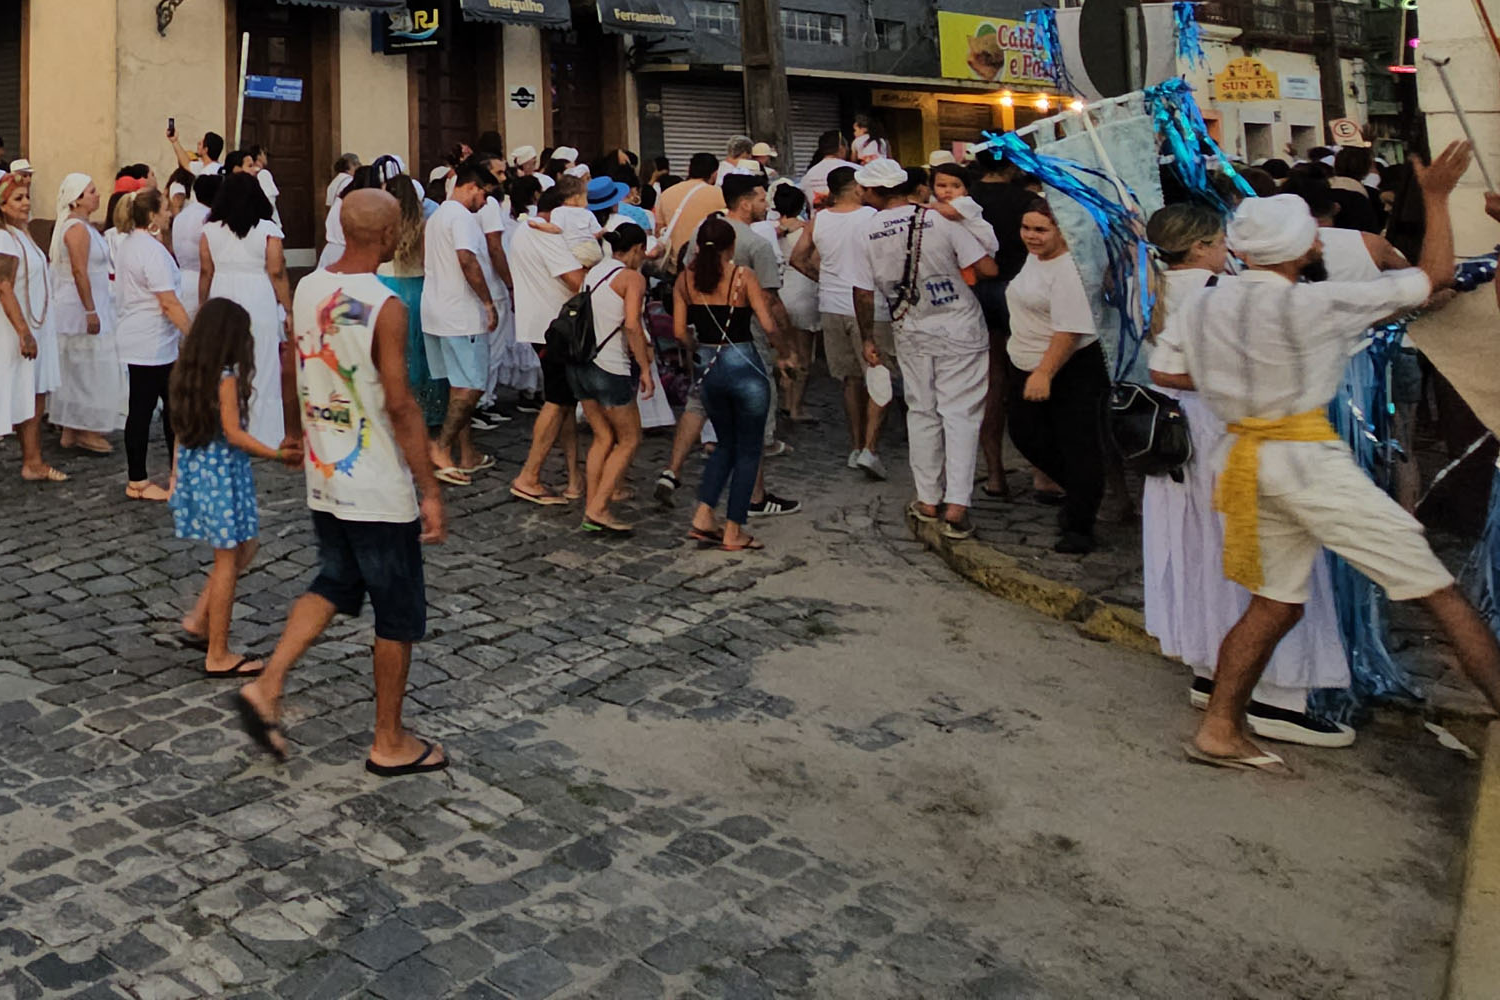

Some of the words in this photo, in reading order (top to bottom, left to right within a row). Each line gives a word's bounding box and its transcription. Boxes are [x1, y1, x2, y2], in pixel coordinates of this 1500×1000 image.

[414, 8, 439, 30] RJ
[613, 8, 676, 26] Ferramentas
[1010, 58, 1018, 75] e
[1222, 81, 1249, 90] SUN
[1256, 80, 1273, 89] FA
[1341, 125, 1349, 135] E
